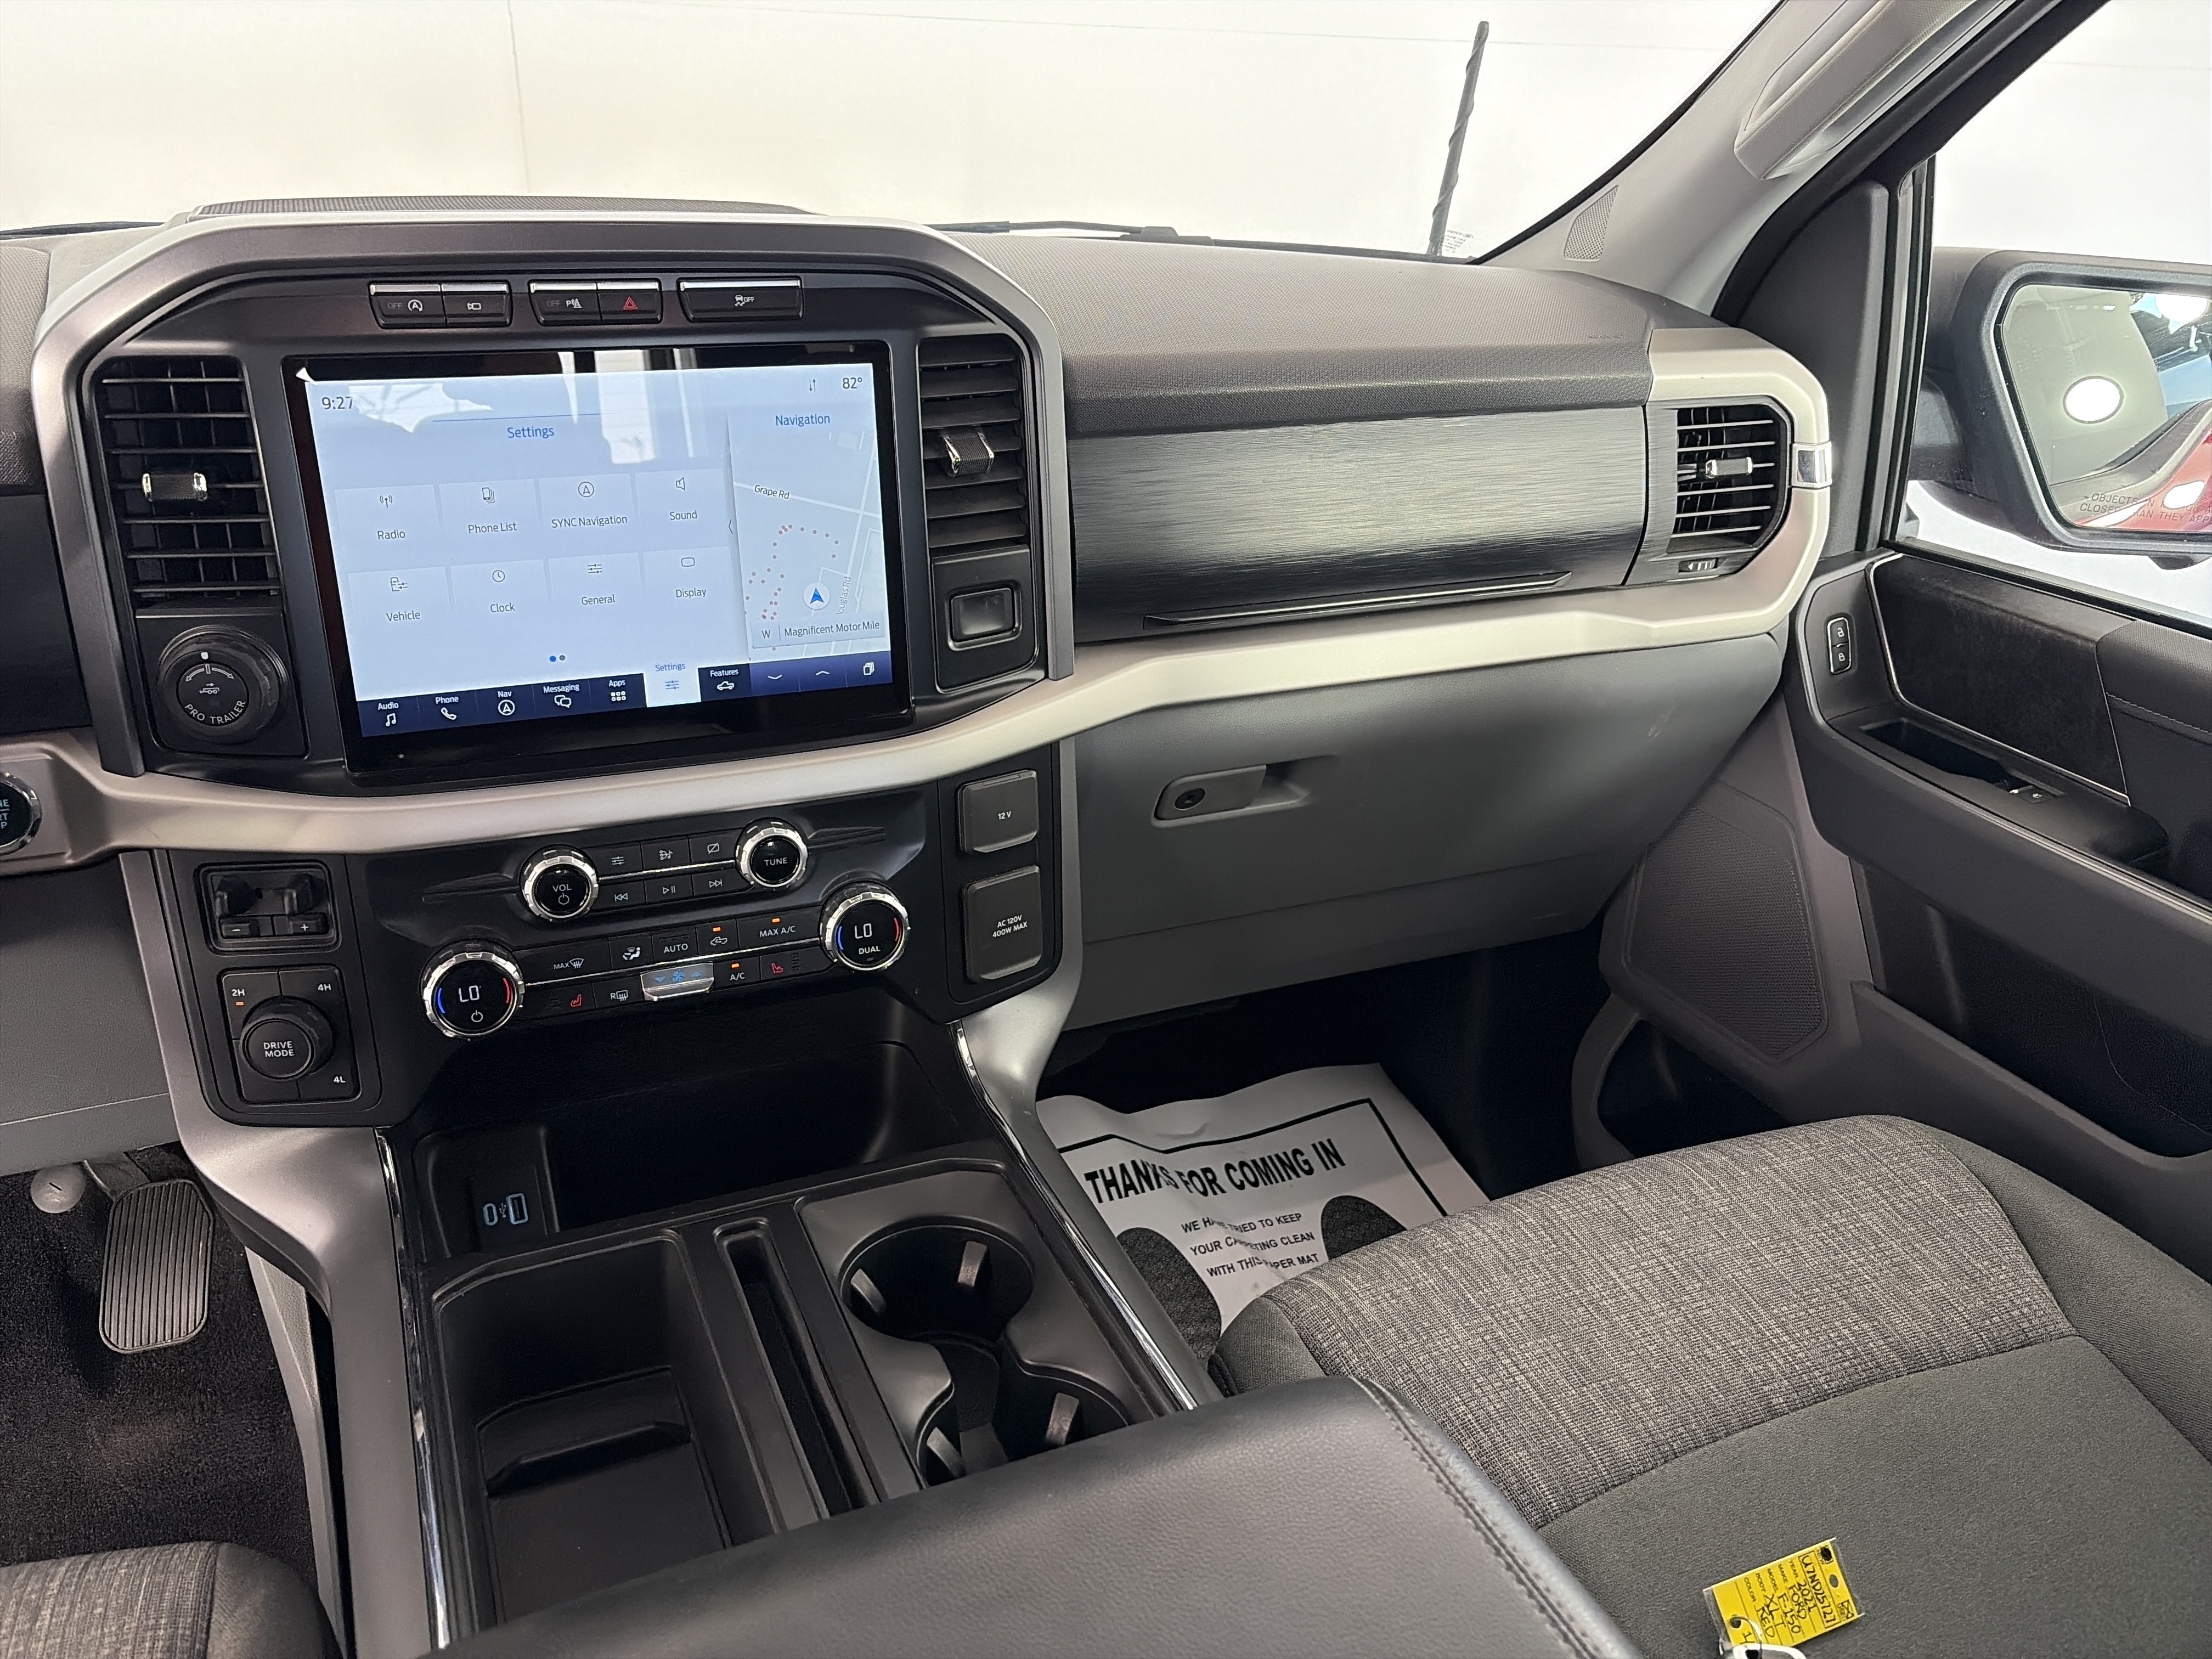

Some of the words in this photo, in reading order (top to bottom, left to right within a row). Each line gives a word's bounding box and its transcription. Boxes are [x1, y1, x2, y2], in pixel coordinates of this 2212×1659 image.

[842, 377, 862, 389] 82°
[321, 396, 353, 410] 9:27
[775, 414, 830, 426] Navigation
[507, 425, 555, 439] Settings
[754, 485, 778, 498] Grape
[778, 490, 790, 500] Rd
[670, 510, 698, 521] Sound
[2159, 511, 2186, 521] THEY
[468, 523, 499, 534] Phone
[500, 522, 517, 532] List
[551, 517, 577, 529] SYNC
[579, 515, 628, 527] Navigation
[377, 529, 405, 540] Radio
[843, 576, 851, 588] Rd
[675, 587, 707, 599] Display
[582, 594, 616, 606] General
[490, 602, 515, 613] Clock
[386, 611, 421, 622] Vehicle
[761, 629, 771, 639] W
[784, 625, 834, 637] Magnificent
[836, 623, 860, 633] Motor
[862, 620, 879, 630] Mile
[654, 662, 686, 672] Settings
[709, 668, 739, 678] Features
[543, 683, 580, 694] Messaging
[608, 678, 626, 688] Apps
[436, 695, 459, 704] Phone
[498, 690, 512, 698] Nav
[377, 701, 399, 710] Audio
[185, 703, 205, 721] PRO
[210, 700, 246, 724] TRAILER
[997, 812, 1006, 820] 12
[764, 857, 788, 866] TUNE
[552, 884, 572, 893] VOL
[997, 919, 1006, 928] AC
[1007, 915, 1023, 924] 120V
[759, 928, 779, 938] MAX
[781, 926, 796, 934] A/C
[854, 923, 872, 940] LO
[992, 927, 1012, 938] 400W
[1013, 921, 1028, 931] MAX
[663, 943, 689, 953] AUTO
[859, 946, 881, 955] DUAL
[730, 972, 746, 981] A/C
[231, 989, 245, 997] 2H
[318, 984, 331, 992] 4H
[459, 985, 479, 1003] LO
[263, 1041, 293, 1050] DRIVE
[264, 1048, 295, 1058] MODE
[333, 1075, 346, 1084] 4L
[1175, 1167, 1227, 1197] FOR
[1224, 1148, 1314, 1191] COMING
[1312, 1138, 1346, 1171] IN
[1181, 1220, 1200, 1233] WE
[1257, 1218, 1273, 1228] TO
[1275, 1213, 1302, 1225] KEEP
[1190, 1240, 1223, 1256] YOUR
[1280, 1232, 1315, 1245] CLEAN
[1206, 1263, 1235, 1277] WITH
[1237, 1256, 1263, 1270] THIS
[1296, 1254, 1319, 1265] MAT
[1778, 1564, 1788, 1583] MAKE
[1788, 1560, 1799, 1578] YEAR
[1756, 1572, 1767, 1592] BODY
[1767, 1568, 1779, 1592] MODEL
[1744, 1577, 1756, 1602] COLOR
[1788, 1583, 1807, 1619] FORD
[1796, 1579, 1817, 1613] 2021
[1764, 1594, 1786, 1628] XLT
[1778, 1593, 1801, 1634] F-150
[1757, 1606, 1775, 1638] RED
